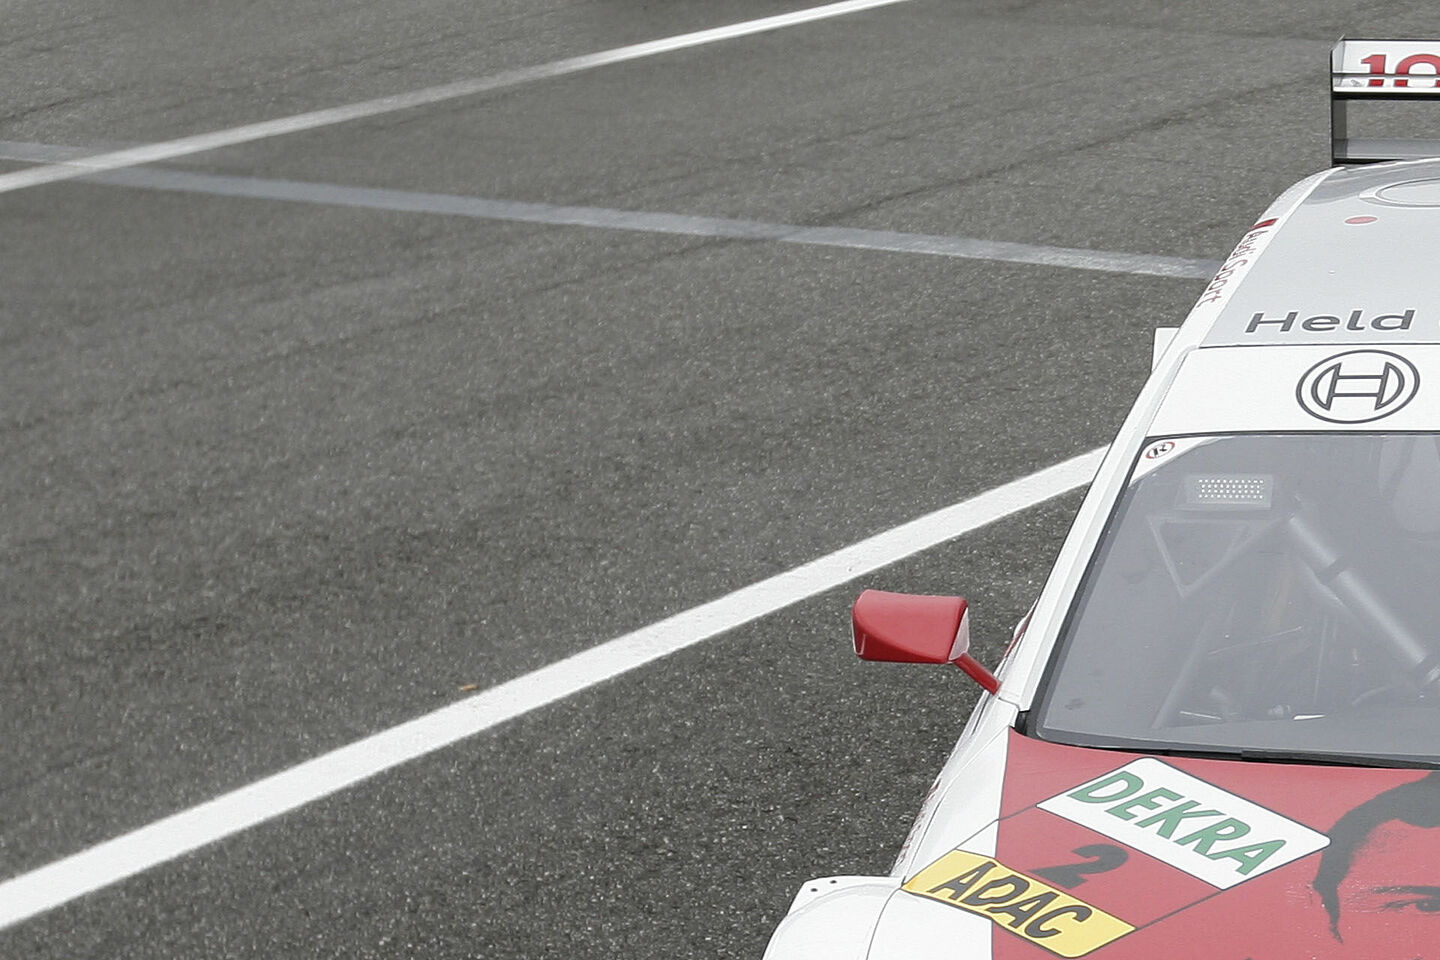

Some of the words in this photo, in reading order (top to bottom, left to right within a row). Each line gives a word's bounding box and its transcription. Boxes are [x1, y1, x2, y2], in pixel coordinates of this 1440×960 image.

[1245, 309, 1416, 333] Held
[1066, 770, 1287, 875] DEKRA
[1032, 843, 1130, 890] 2
[928, 861, 1094, 939] ADAC
